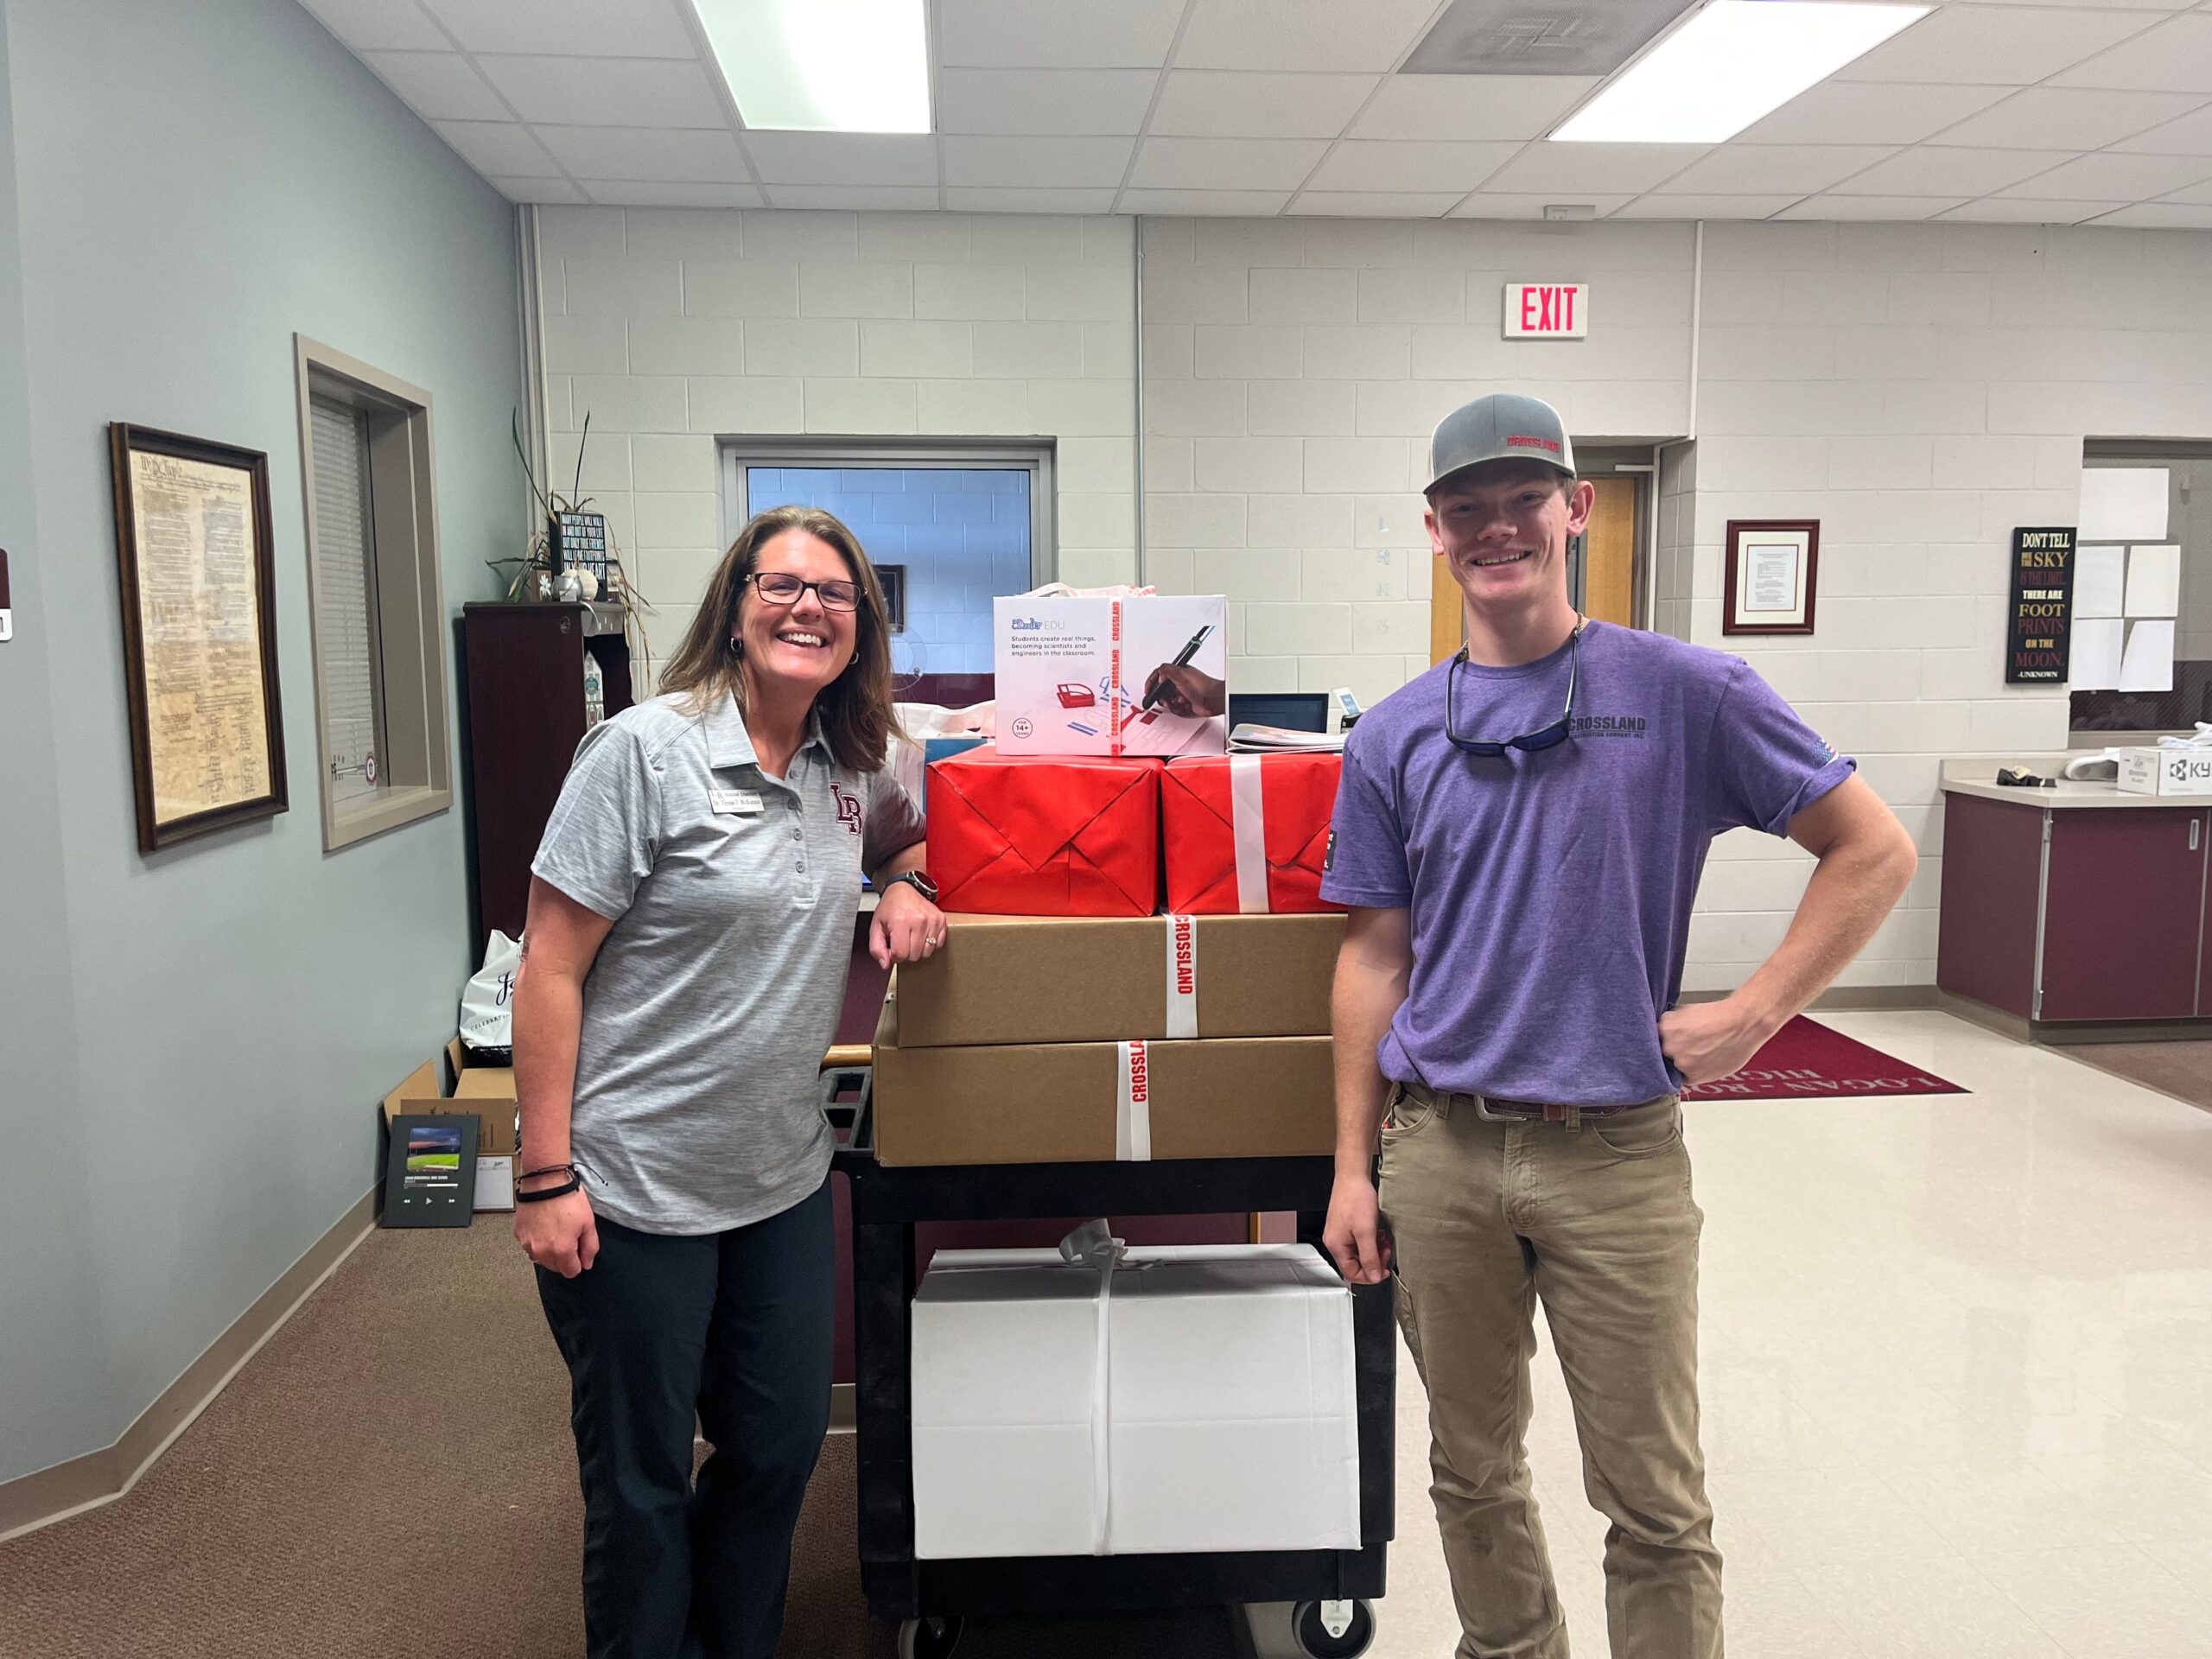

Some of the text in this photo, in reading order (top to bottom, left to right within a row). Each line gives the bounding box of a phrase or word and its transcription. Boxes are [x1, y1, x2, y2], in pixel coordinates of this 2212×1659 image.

[1522, 287, 1578, 331] EXIT
[1507, 435, 1560, 454] CROSSLAND
[2049, 532, 2070, 548] TELL
[2033, 551, 2069, 567] SKY
[2023, 590, 2063, 600] THERE ARE
[2018, 604, 2065, 617] FOOT
[1044, 620, 1065, 630] EDU
[2018, 618, 2065, 634] PRINTS
[2025, 639, 2054, 648] ON THE
[2015, 652, 2065, 667] MOON.
[1111, 649, 1120, 689] CROSSLAND
[1173, 915, 1193, 995] CROSSLAND
[1783, 1077, 1942, 1092] LOGAN
